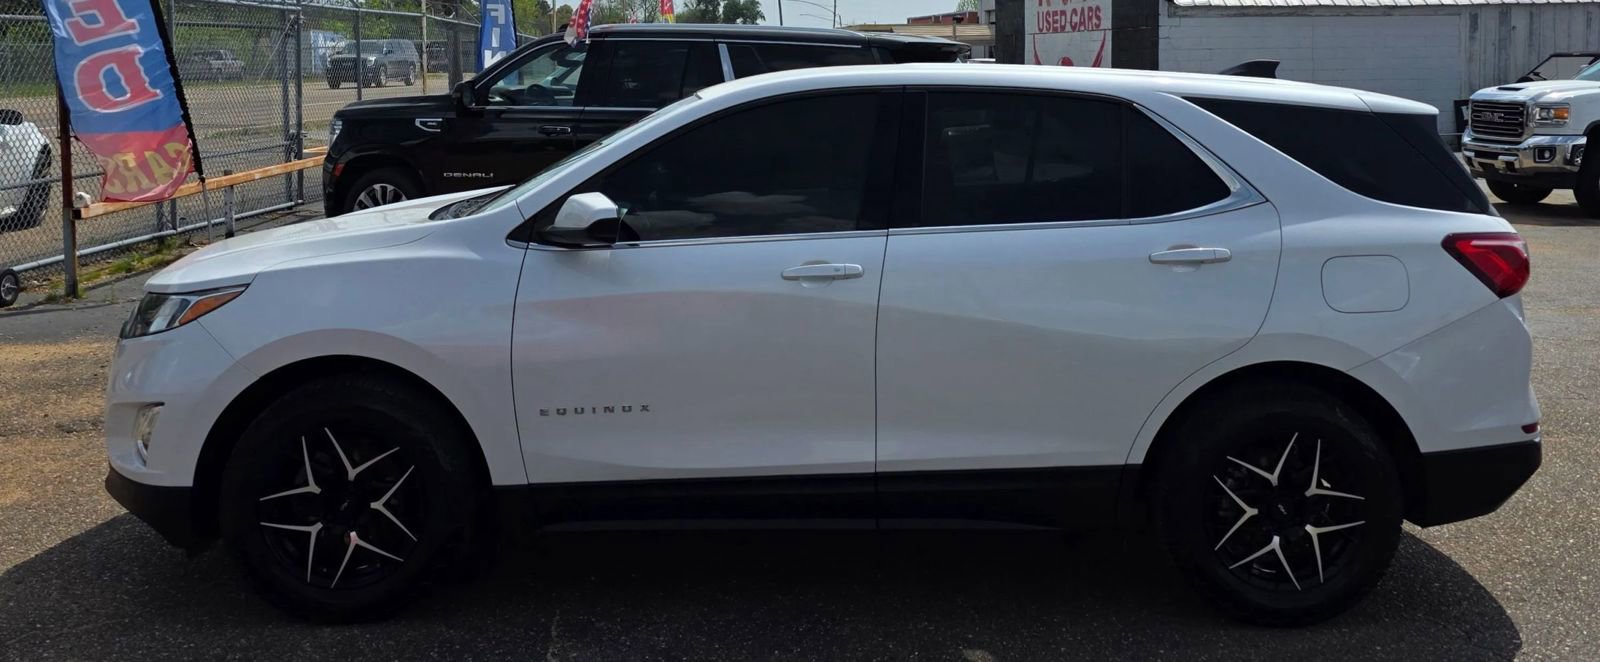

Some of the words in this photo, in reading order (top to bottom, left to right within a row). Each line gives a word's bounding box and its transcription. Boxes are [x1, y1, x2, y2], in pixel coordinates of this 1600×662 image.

[1037, 9, 1067, 32] USED
[1070, 5, 1102, 32] CARS
[539, 404, 651, 417] EQUINOX
